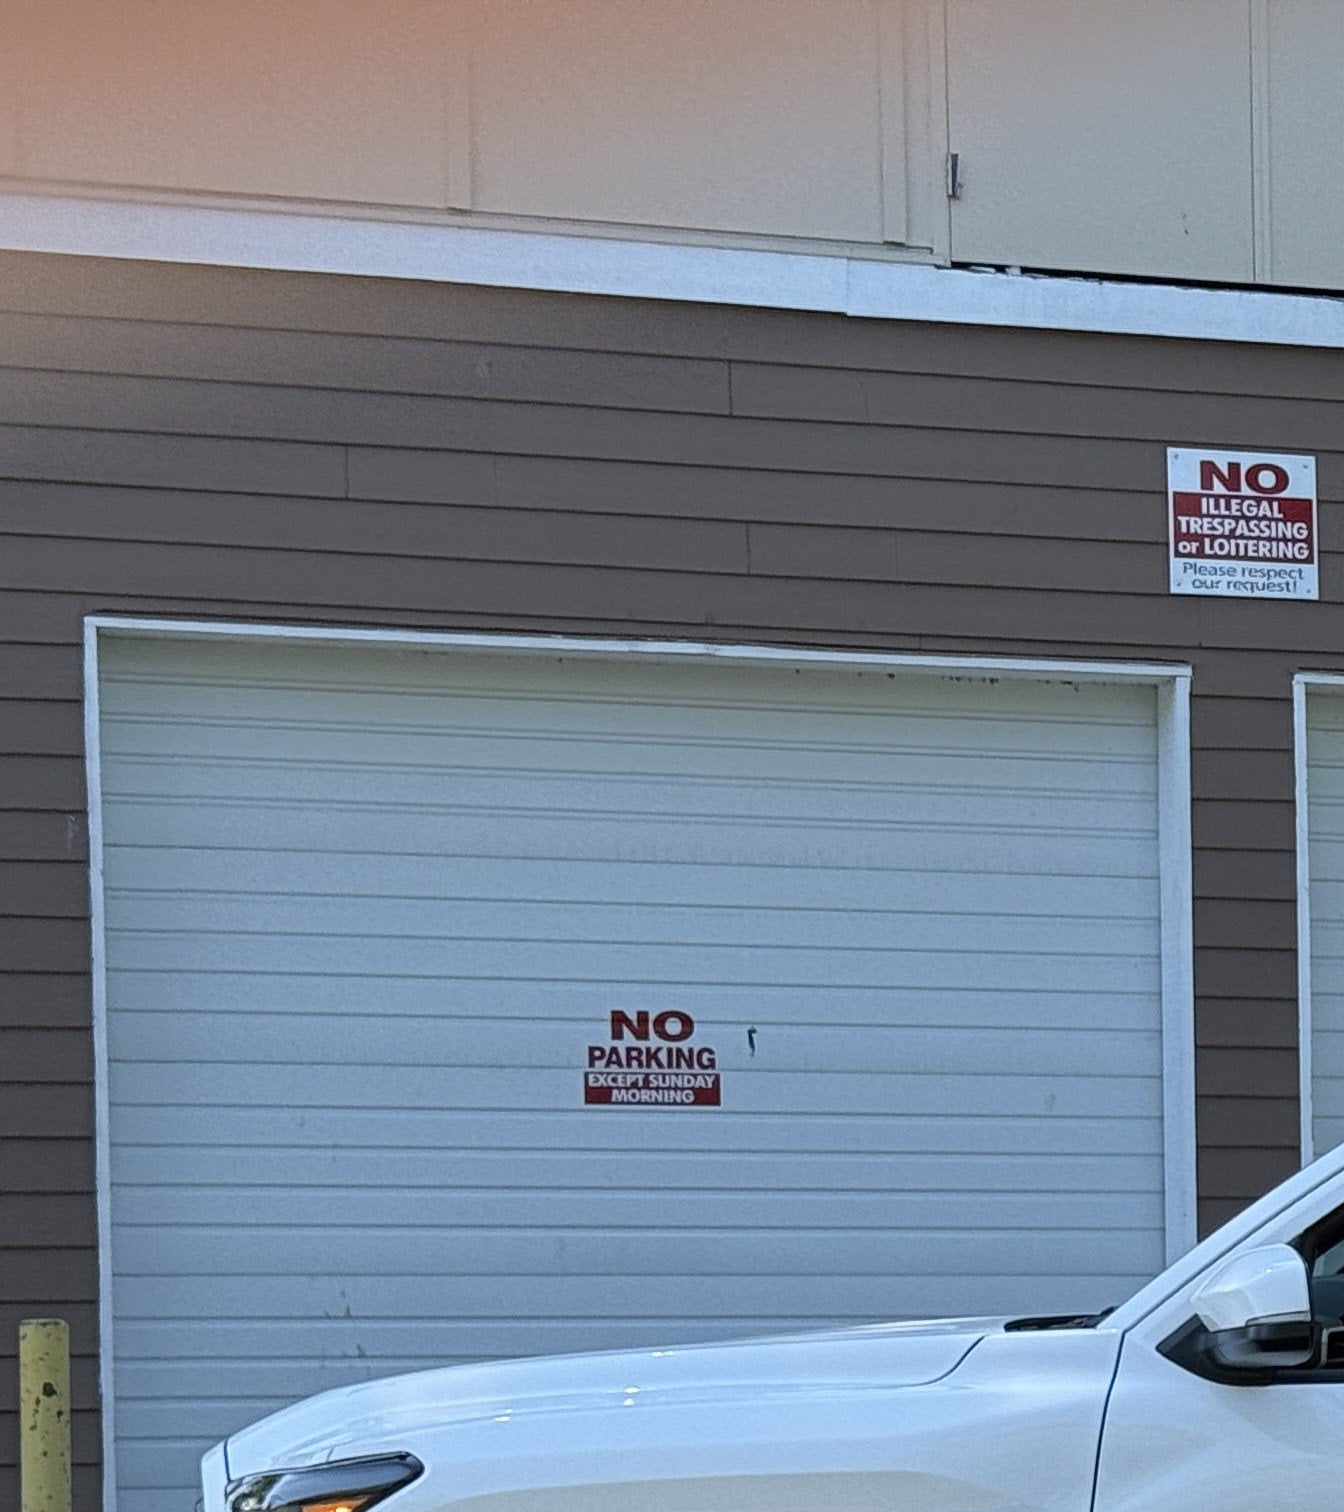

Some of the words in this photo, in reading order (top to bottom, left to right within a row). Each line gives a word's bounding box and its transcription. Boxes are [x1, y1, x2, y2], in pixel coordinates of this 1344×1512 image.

[1200, 460, 1290, 495] NO
[1201, 497, 1284, 518] ILLEGAL
[1177, 516, 1309, 539] TRESPASSING
[1178, 541, 1200, 554] or
[1203, 537, 1310, 560] LOITERING
[1182, 562, 1237, 578] Please
[1241, 566, 1305, 582] respect
[1192, 578, 1221, 590] our
[1226, 580, 1298, 594] request!
[611, 1010, 695, 1042] NO
[588, 1045, 716, 1070] PARKING
[588, 1073, 644, 1088] EXCEPT
[649, 1074, 715, 1089] SUNDAY
[611, 1089, 695, 1104] MORNING
